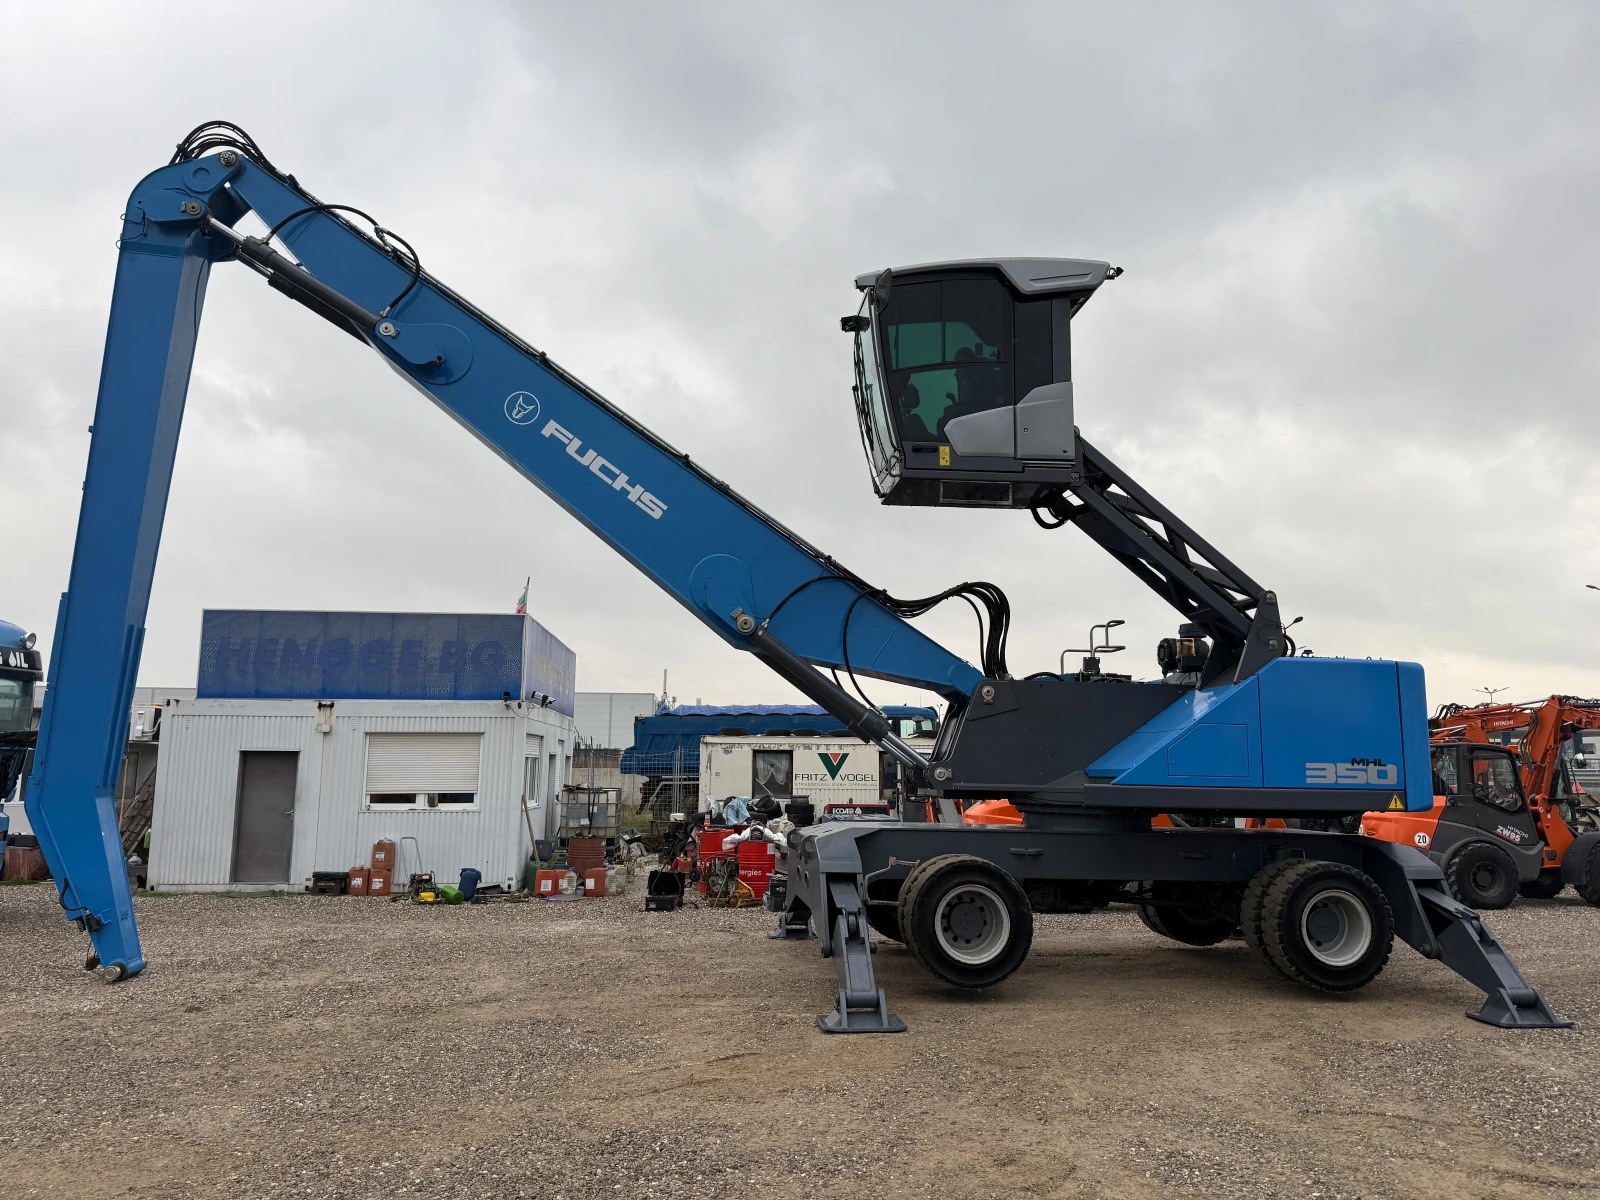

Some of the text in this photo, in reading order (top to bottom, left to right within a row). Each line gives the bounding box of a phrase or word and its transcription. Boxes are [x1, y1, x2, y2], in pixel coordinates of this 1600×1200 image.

[540, 419, 668, 520] FUCHS
[215, 638, 506, 674] HENGGE.BG
[1351, 758, 1387, 767] MHL
[794, 773, 878, 781] FRITZ VOGEL
[1305, 763, 1397, 785] 350
[1416, 834, 1427, 844] 20
[1496, 825, 1521, 841] ZW95
[1507, 825, 1529, 839] HITACHI
